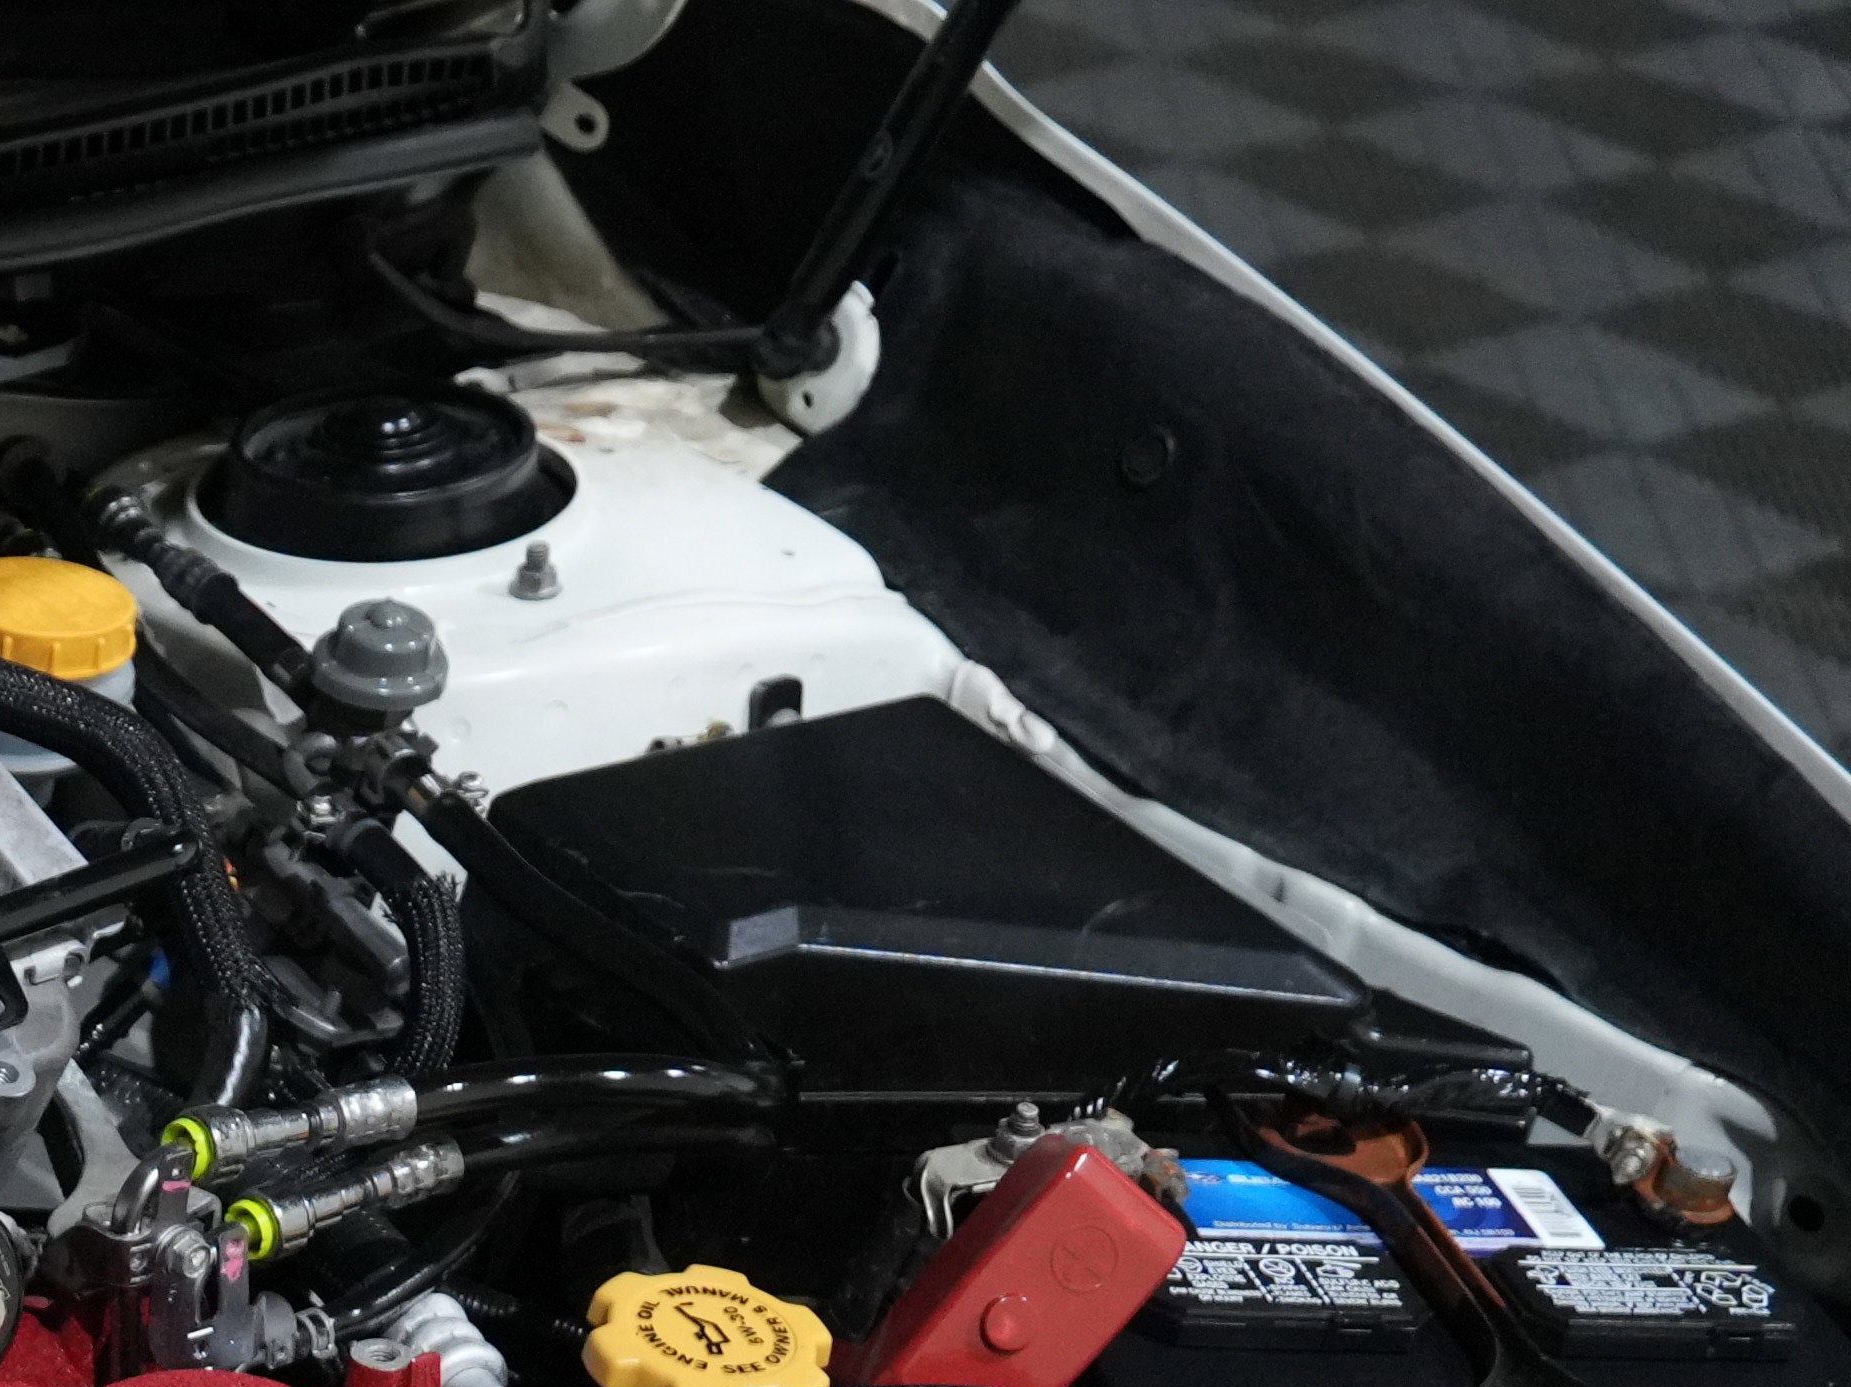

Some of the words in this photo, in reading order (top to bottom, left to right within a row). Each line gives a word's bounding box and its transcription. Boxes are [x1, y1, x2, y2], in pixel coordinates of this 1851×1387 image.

[1184, 1241, 1255, 1254] ANGER
[1275, 1243, 1359, 1257] POISON
[659, 1285, 749, 1305] MANUAL
[637, 1300, 661, 1319] OIL
[639, 1323, 709, 1370] ENGINE
[721, 1361, 766, 1374] SEE
